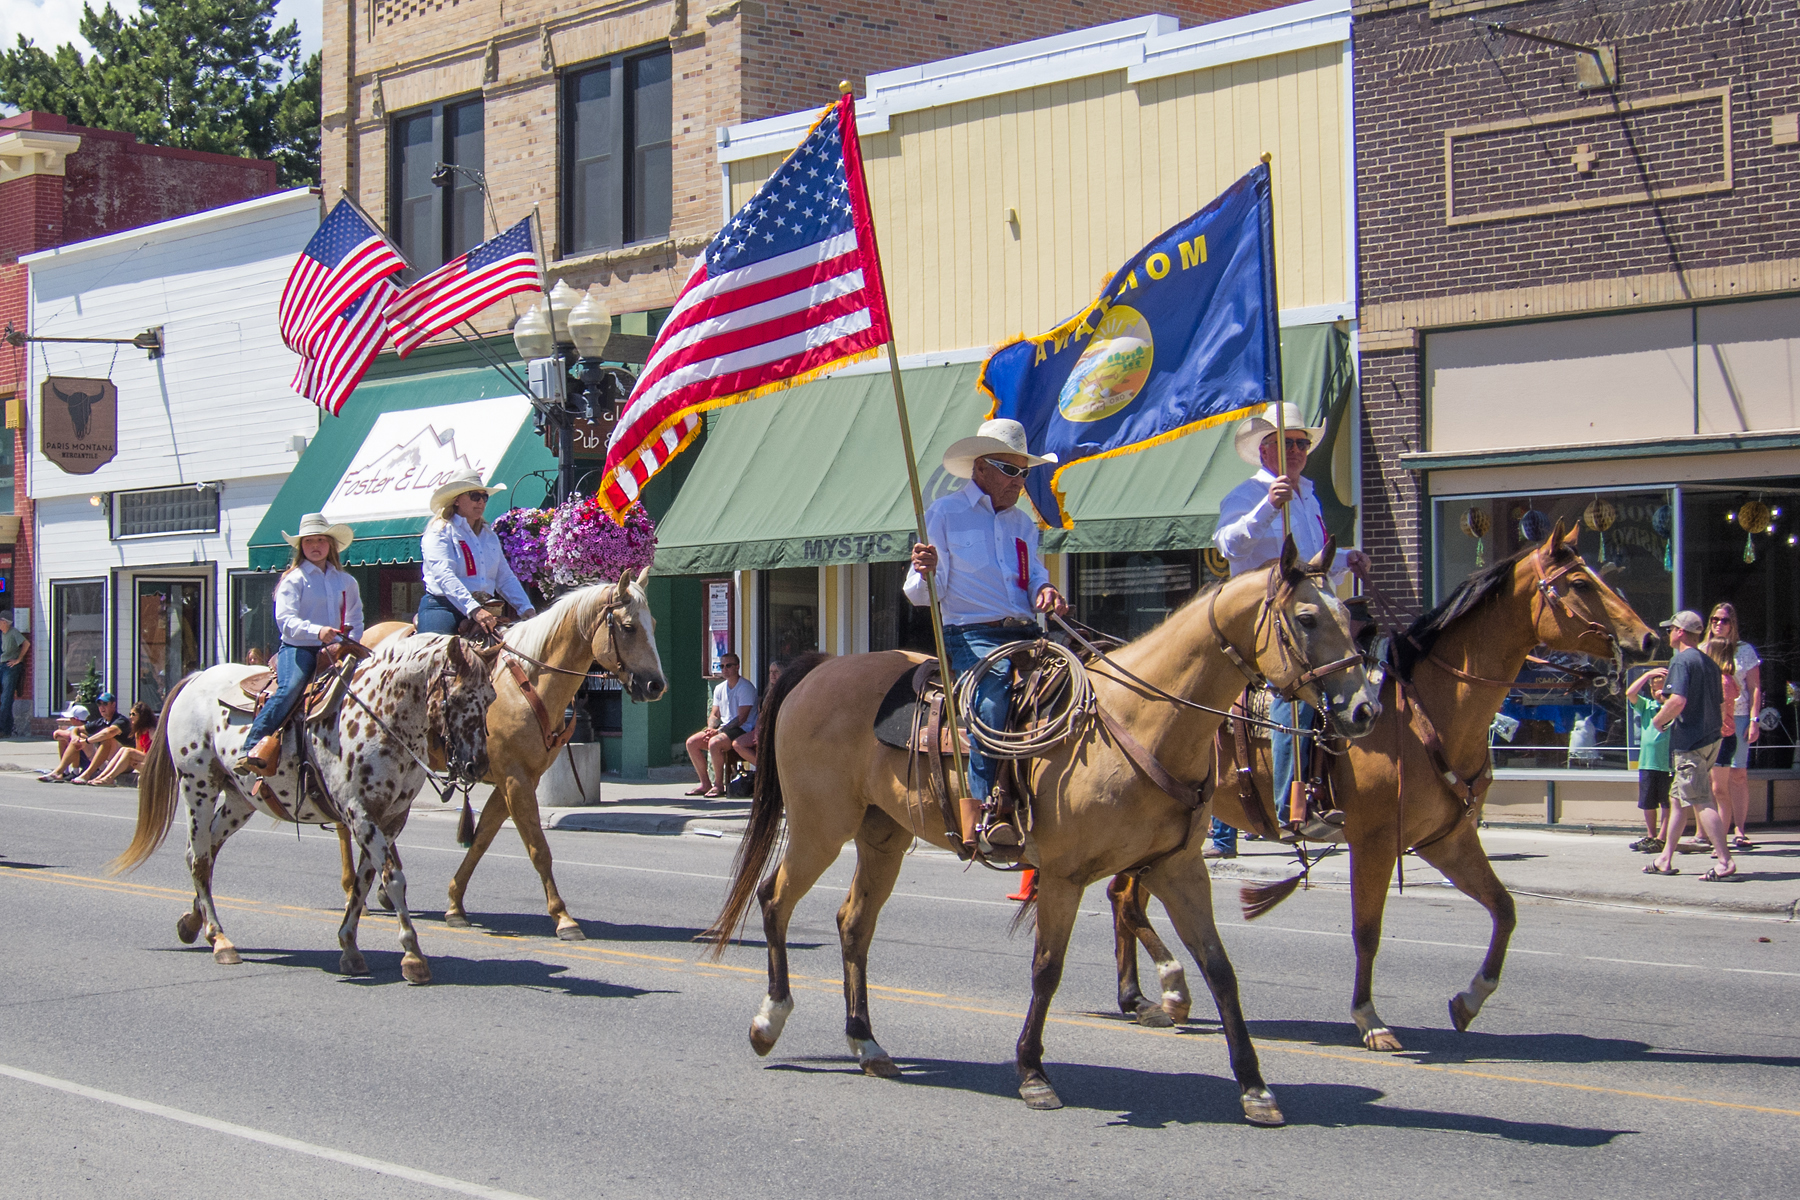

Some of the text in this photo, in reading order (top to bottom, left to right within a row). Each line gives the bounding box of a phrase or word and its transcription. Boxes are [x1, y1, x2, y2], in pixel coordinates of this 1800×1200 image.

[46, 442, 114, 451] PARIS MONTANA
[61, 451, 99, 460] MERCANTILE
[331, 468, 395, 502] Foster
[394, 466, 417, 491] &
[803, 533, 893, 560] MYSTIC
